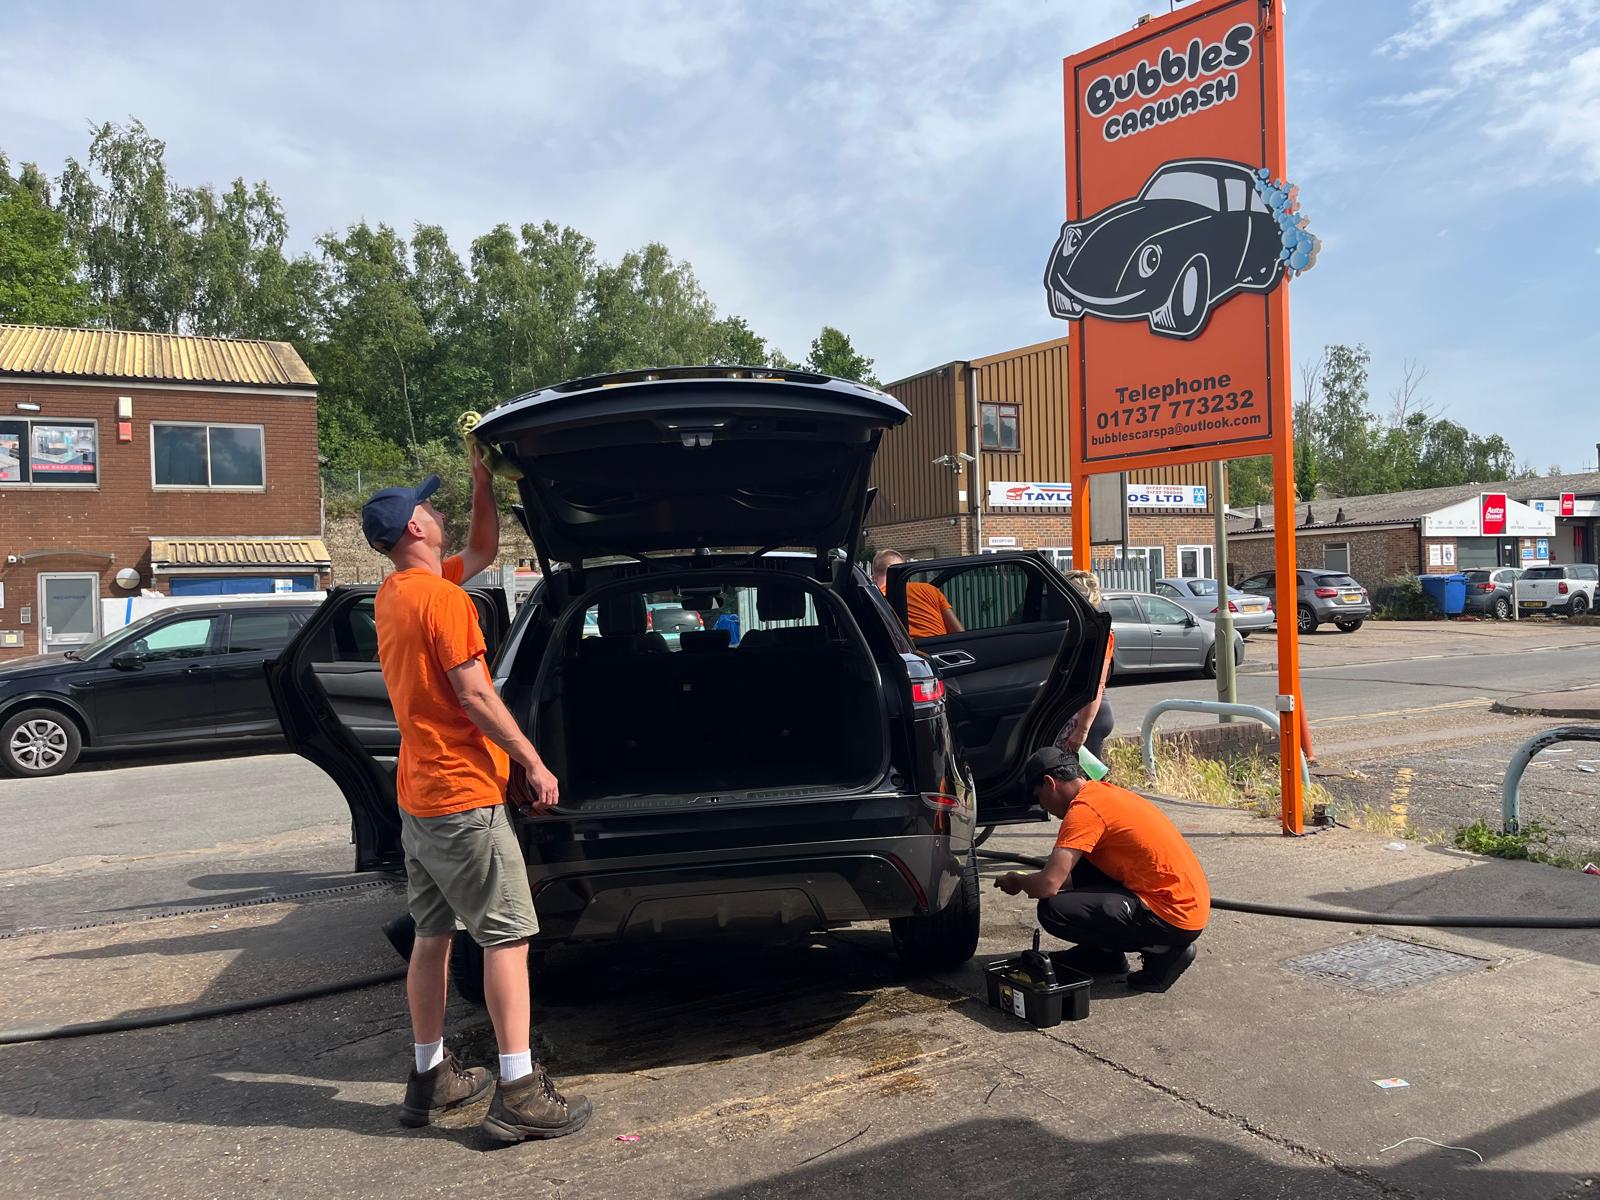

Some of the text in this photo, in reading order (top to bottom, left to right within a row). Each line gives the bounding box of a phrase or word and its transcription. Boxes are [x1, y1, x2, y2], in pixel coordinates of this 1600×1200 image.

[1104, 74, 1237, 141] CARWASH
[1116, 374, 1232, 405] Telephone
[1097, 389, 1254, 430] 01737 773232
[1091, 413, 1261, 446] bubblescarspa@outlook.com
